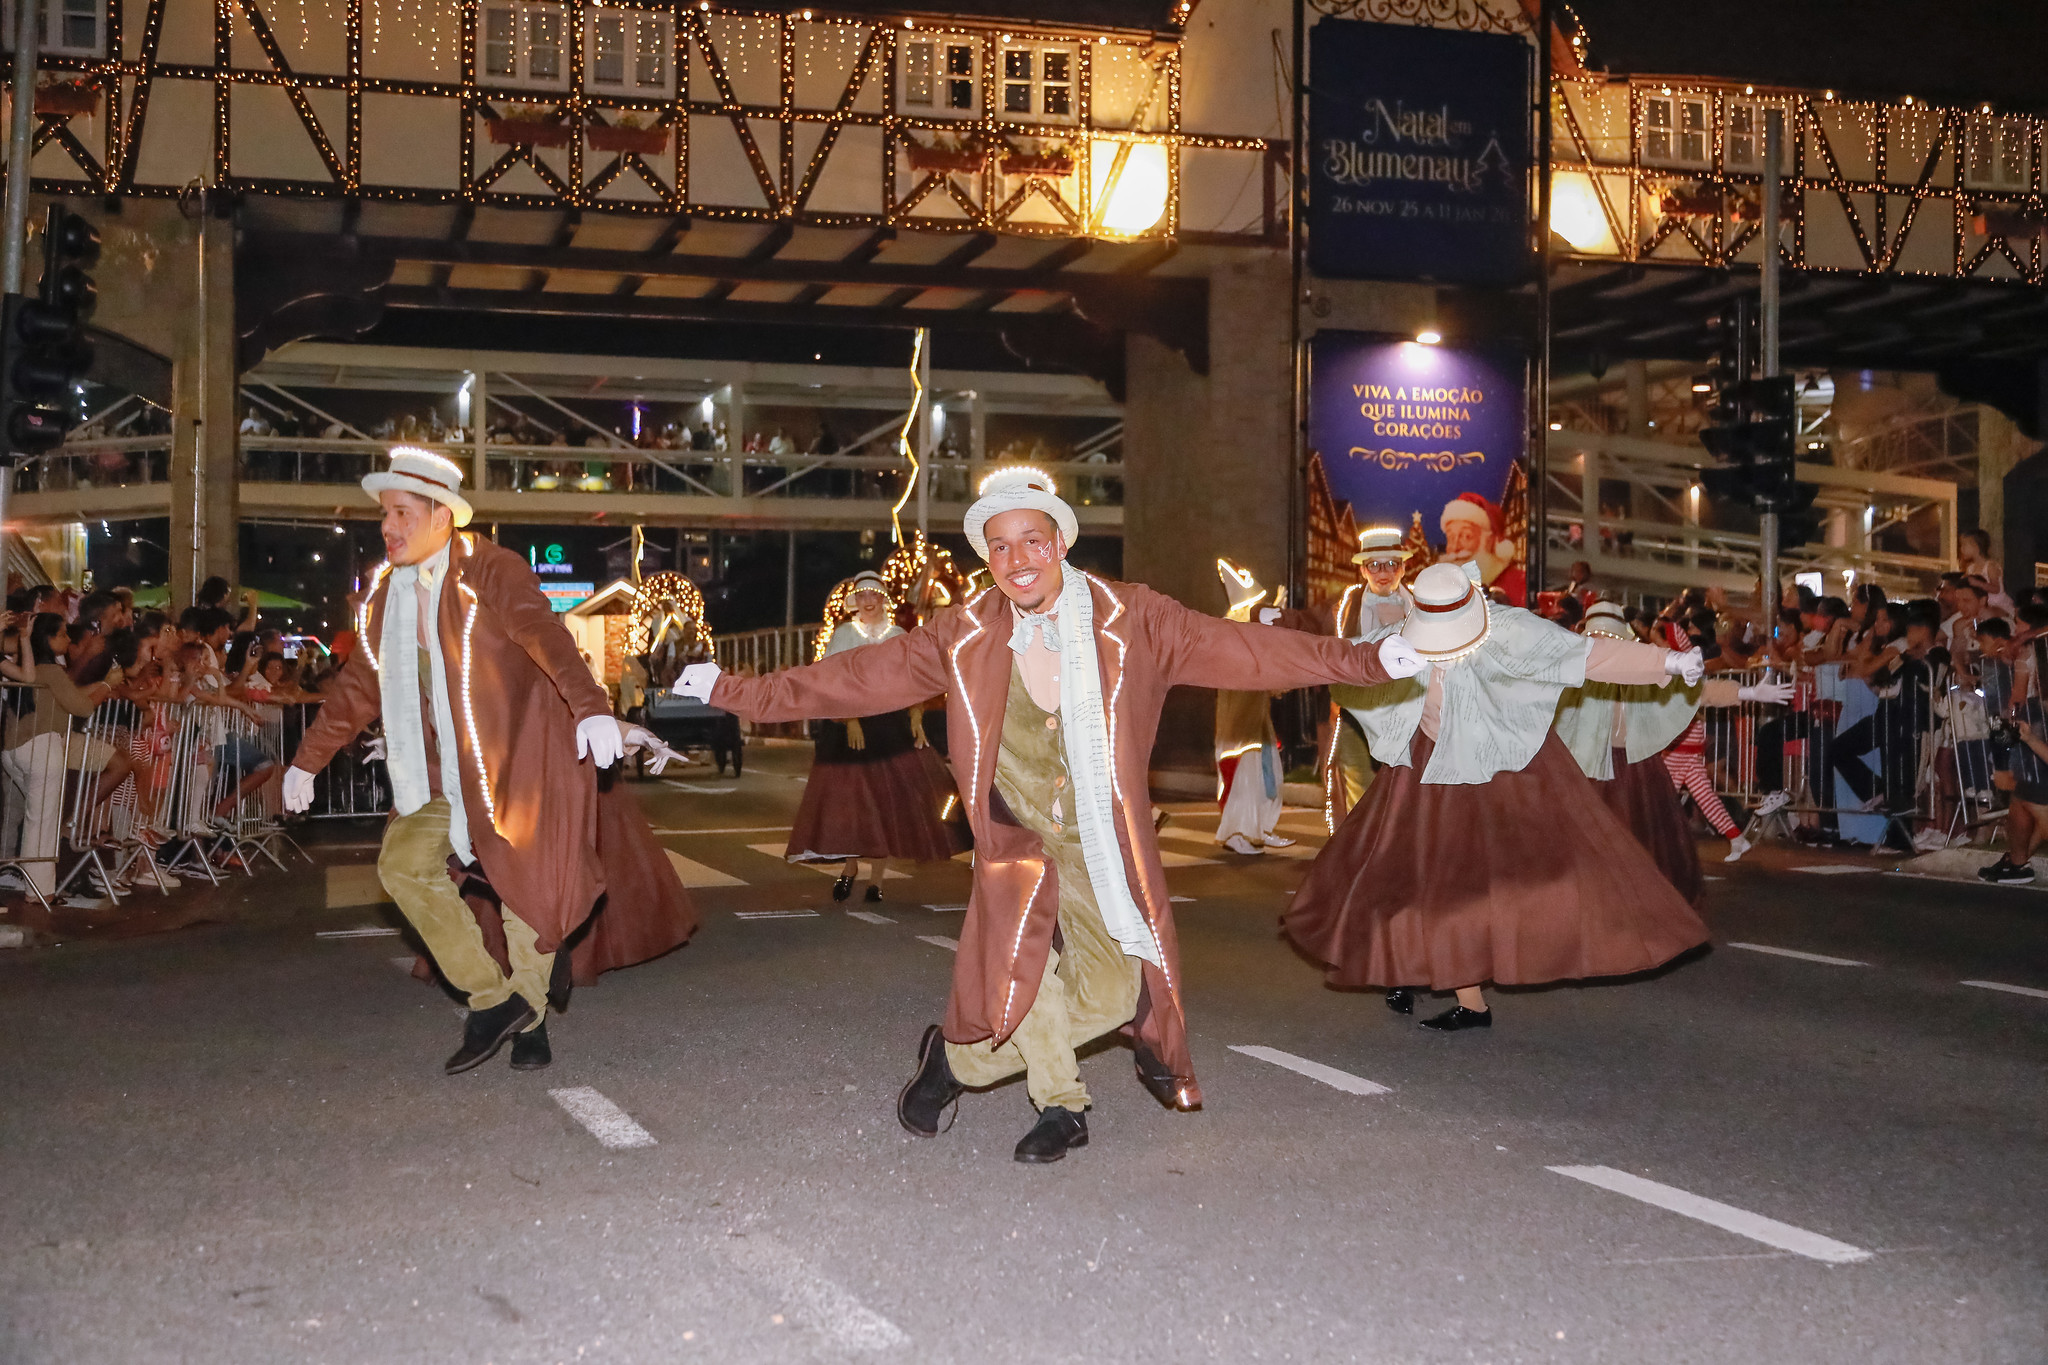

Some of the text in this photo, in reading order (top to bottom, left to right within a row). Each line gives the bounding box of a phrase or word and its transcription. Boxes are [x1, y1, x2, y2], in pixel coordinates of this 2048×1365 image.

[1362, 98, 1451, 146] Natal
[1322, 138, 1474, 192] Blumenau
[1331, 196, 1353, 213] 26
[1356, 199, 1395, 215] NOV
[1353, 384, 1484, 405] VIVA A EMOÇÃO
[1360, 402, 1471, 421] QUE ILUMINA
[1373, 422, 1461, 440] CORAÇÕES
